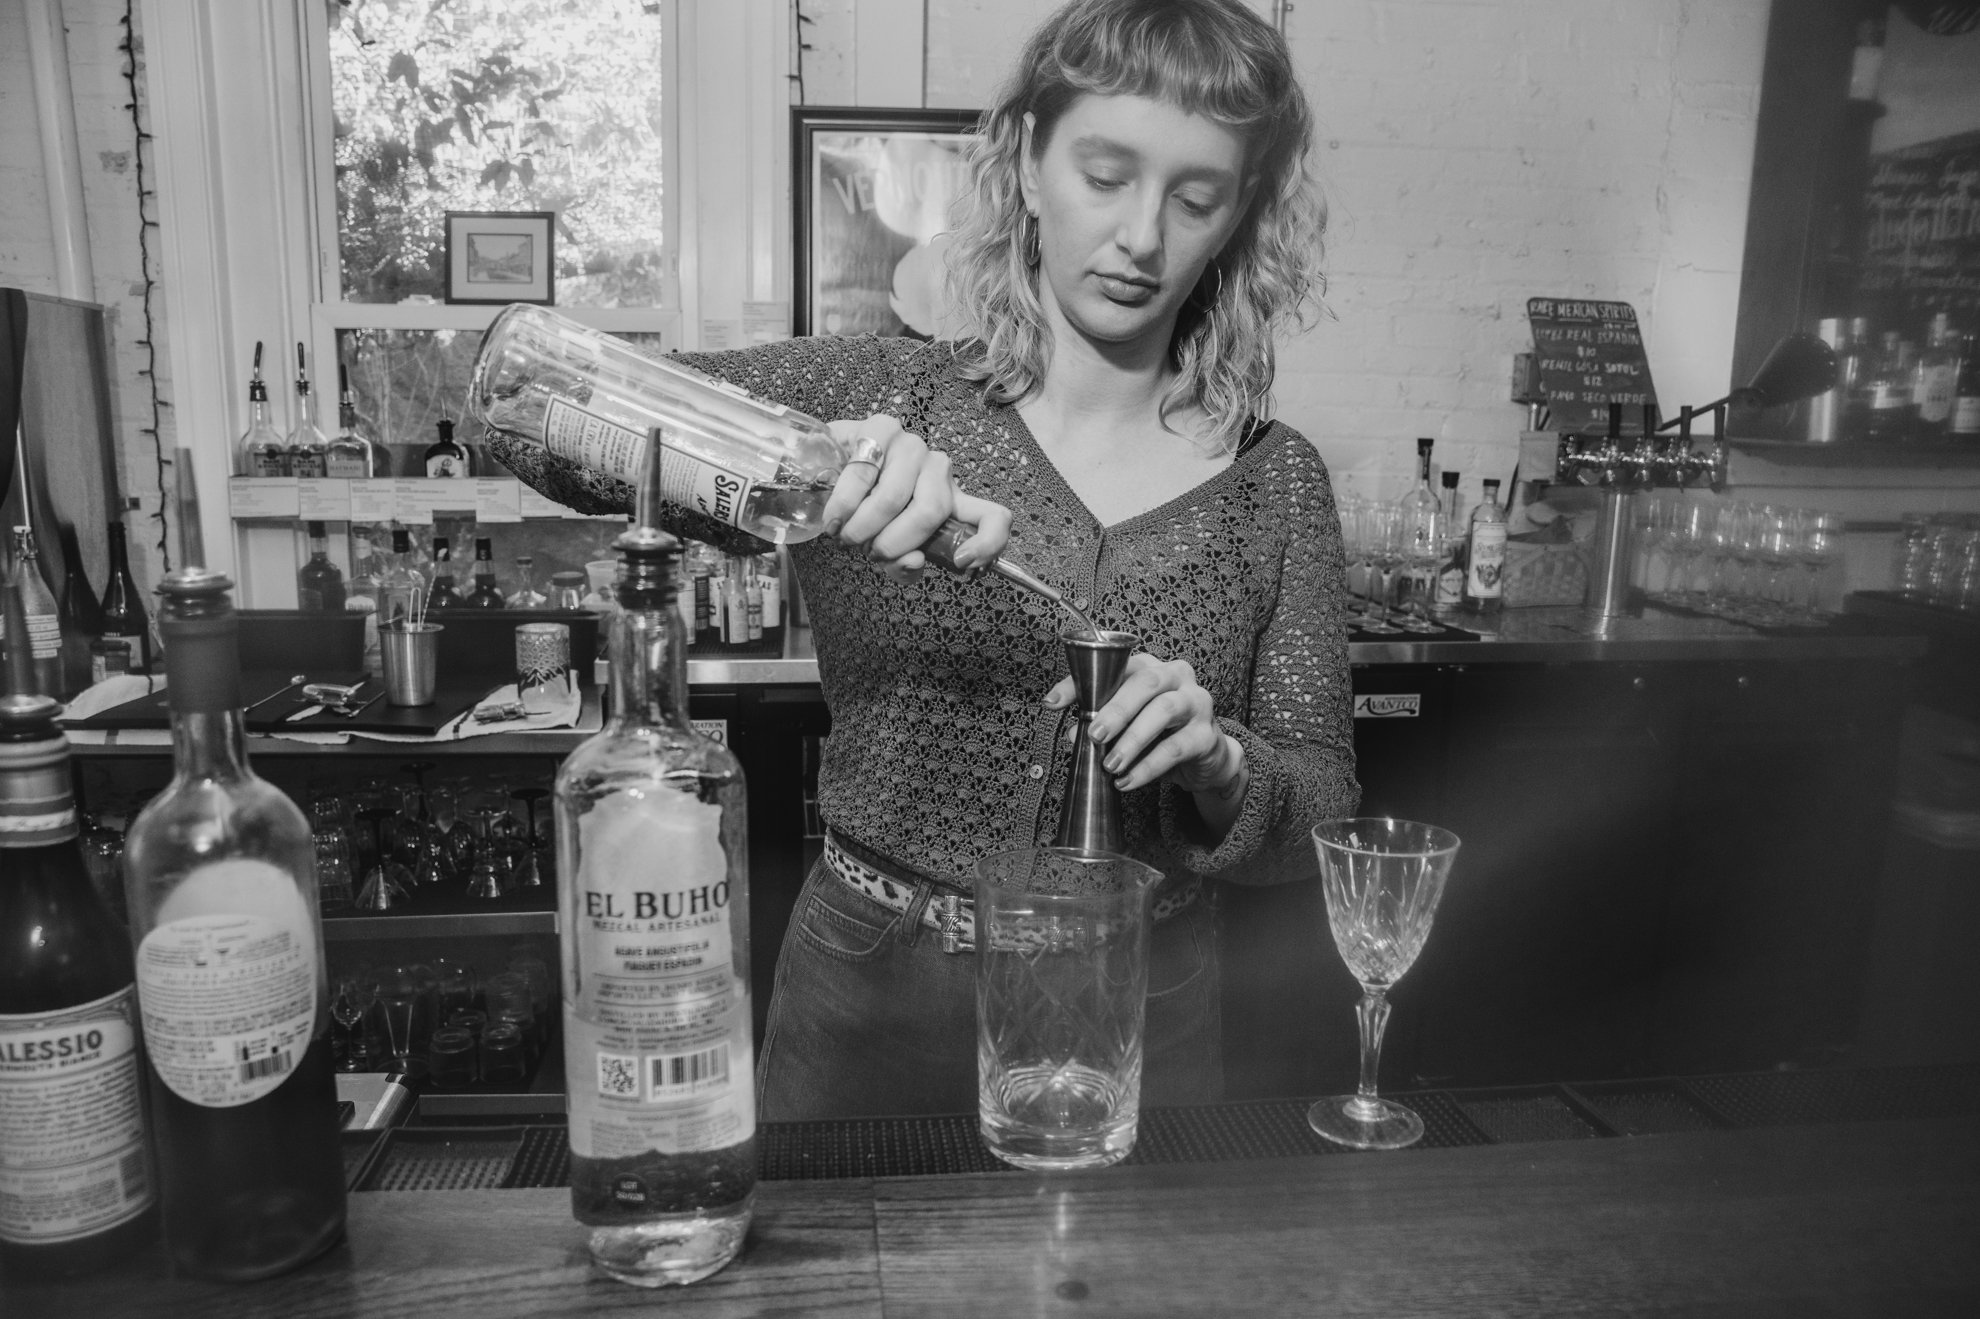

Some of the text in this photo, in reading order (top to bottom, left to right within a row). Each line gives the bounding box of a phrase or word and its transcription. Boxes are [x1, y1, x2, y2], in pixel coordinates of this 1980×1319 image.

[1530, 301, 1635, 320] RARE MEXICAN SPIRITS
[1566, 329, 1594, 343] REAL
[1605, 363, 1640, 375] SOTOL
[1583, 375, 1602, 387] $12
[1610, 393, 1647, 404] VERDE
[714, 474, 740, 521] SALERS
[586, 880, 730, 919] EL BUHO
[592, 911, 721, 933] MEZCAL ARTESANAL
